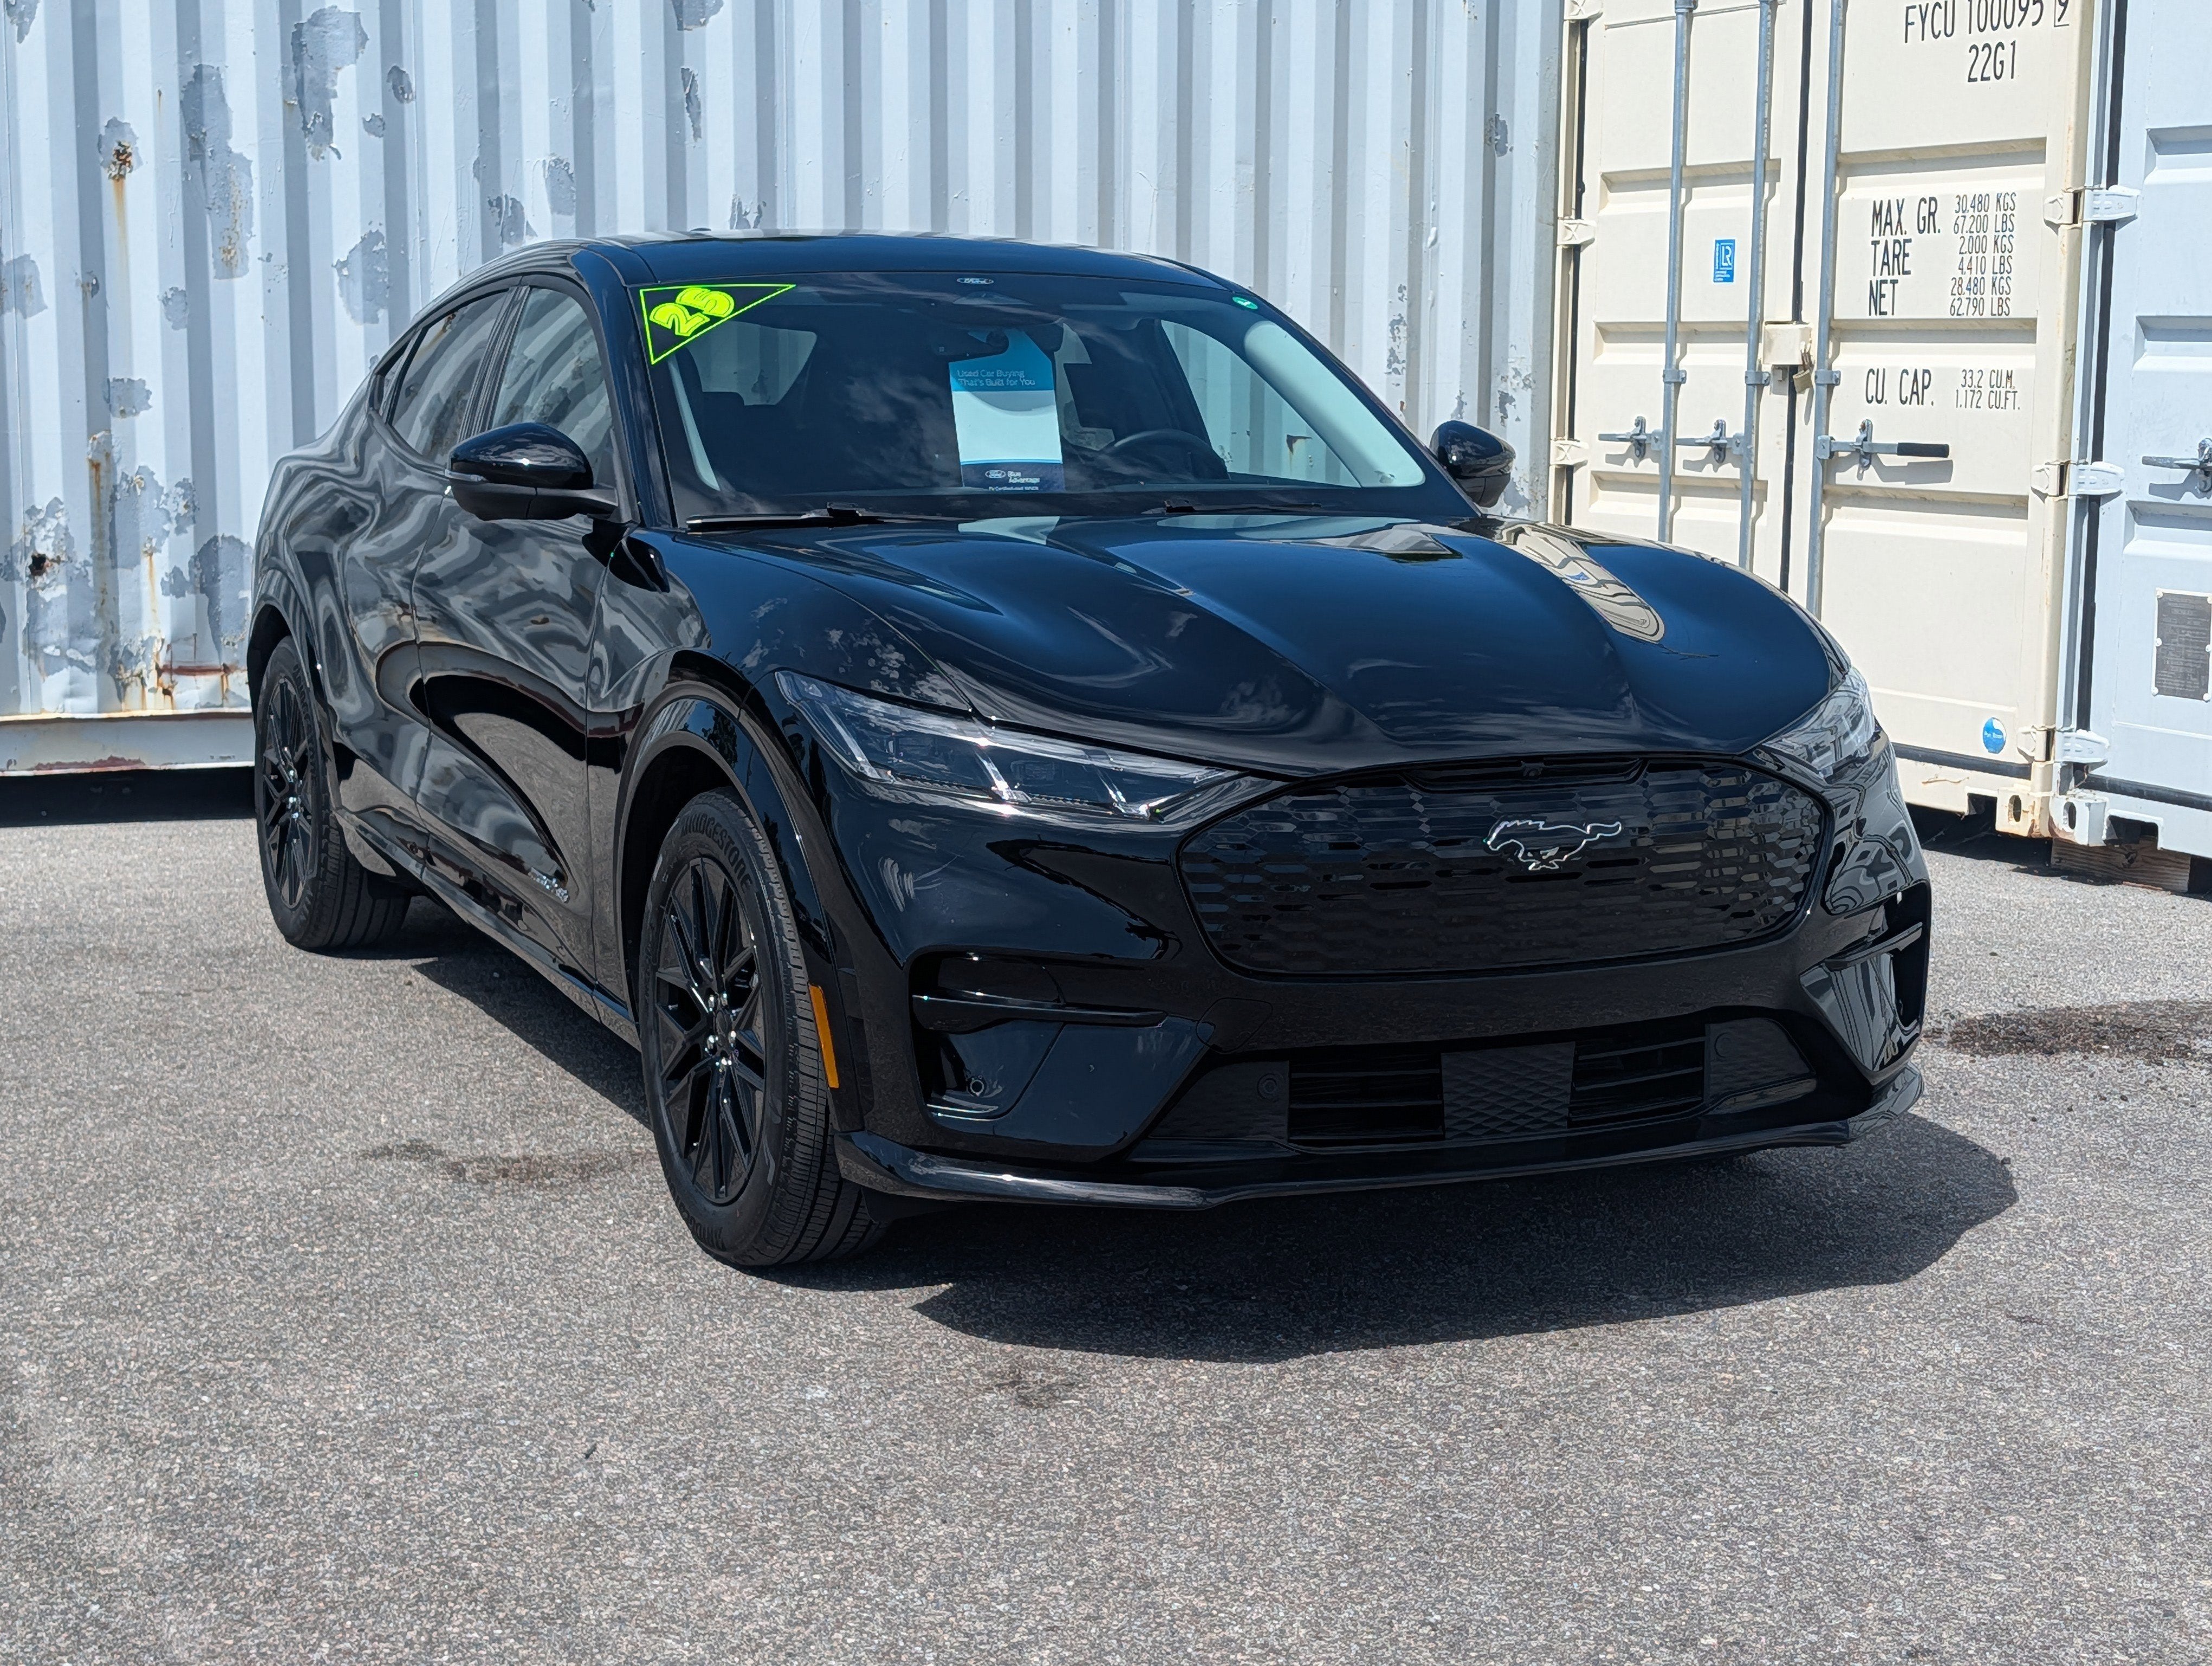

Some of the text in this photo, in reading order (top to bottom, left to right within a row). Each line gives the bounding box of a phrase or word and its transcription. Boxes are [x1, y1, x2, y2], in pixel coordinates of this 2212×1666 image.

[1905, 0, 1955, 43] FYCU
[1967, 40, 2016, 82] 22G1
[1996, 192, 2016, 212] KGS
[1871, 196, 1941, 237] MAX. GR.
[1953, 213, 2015, 234] 67.200 LBS
[1993, 234, 2014, 254] KGS
[1871, 238, 1912, 277] TARE
[1992, 255, 2012, 275] LBS
[1991, 276, 2011, 296] KGS
[1869, 279, 1899, 316] NET
[1990, 297, 2011, 317] LBS
[1866, 368, 1934, 406] CU. CAP.
[1960, 369, 1984, 388] 33.2
